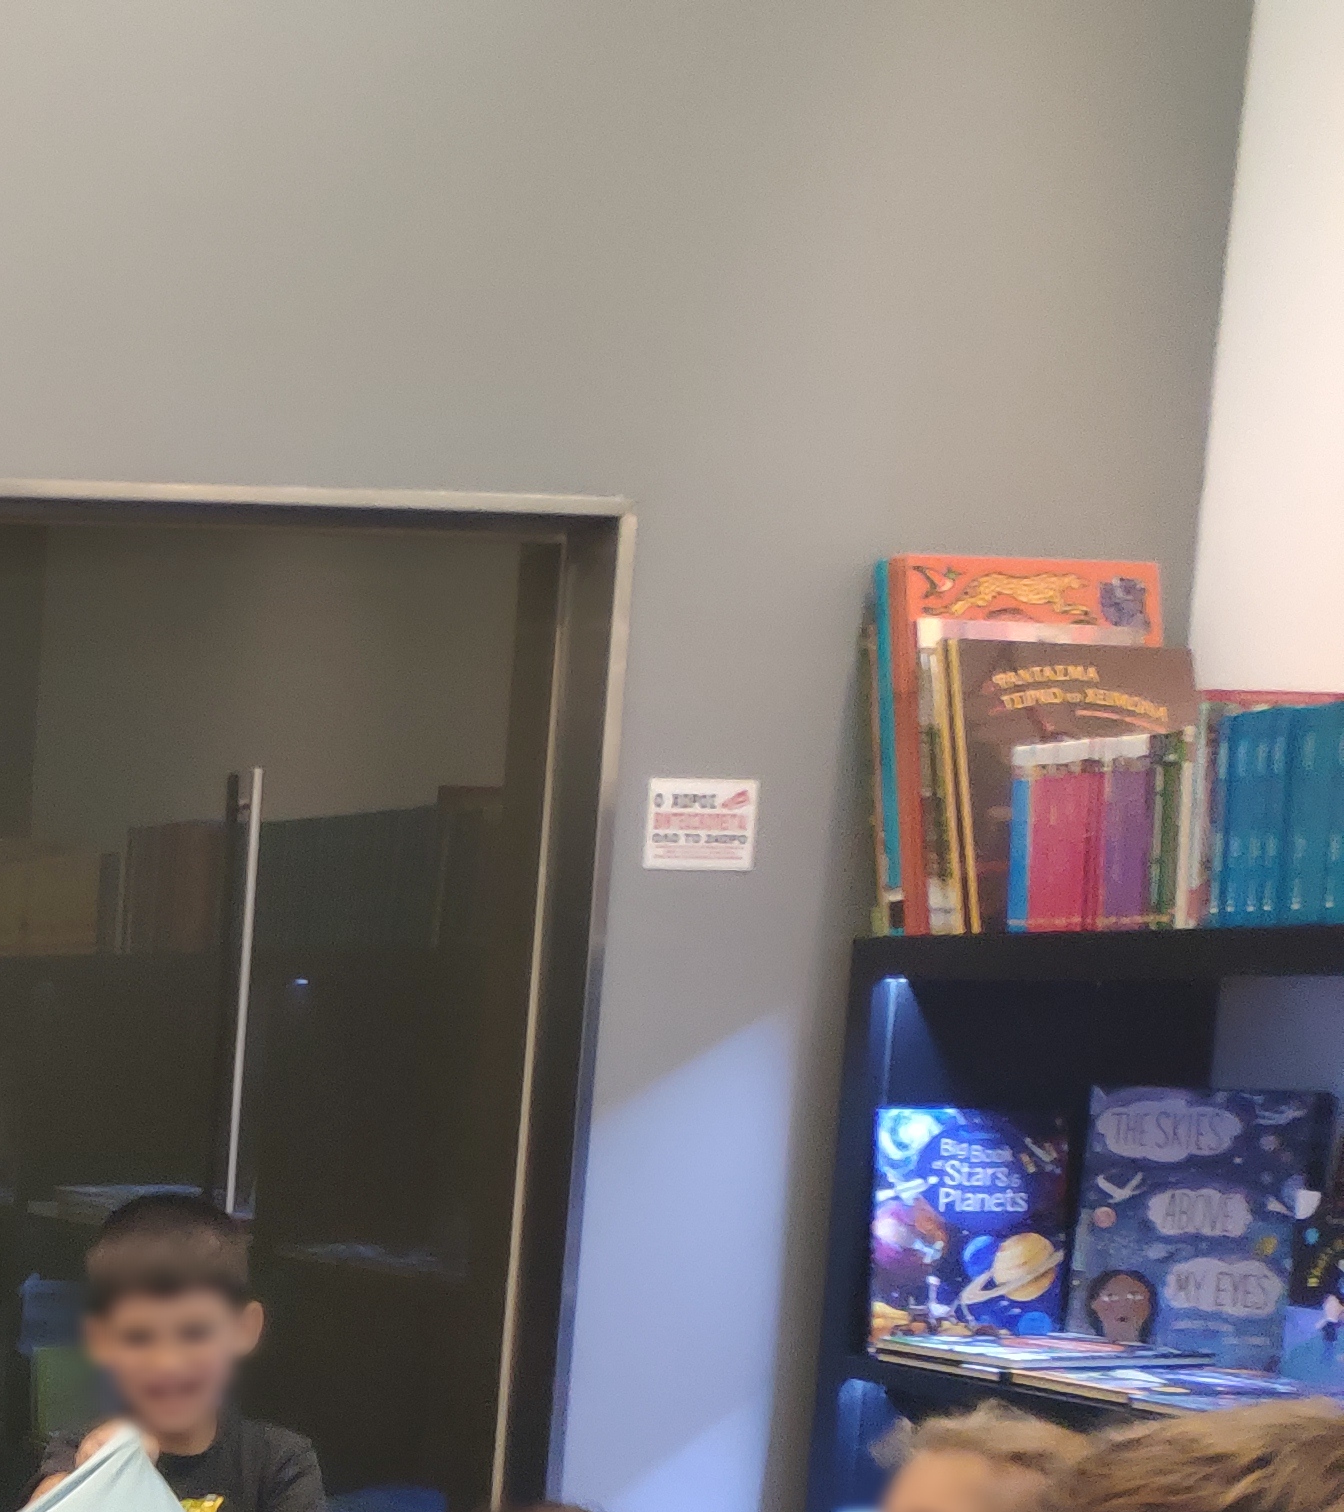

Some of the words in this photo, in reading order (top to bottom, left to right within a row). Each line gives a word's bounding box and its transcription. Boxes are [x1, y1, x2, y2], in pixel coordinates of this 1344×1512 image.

[1111, 1111, 1148, 1148] THE
[1154, 1110, 1222, 1151] SKIES
[940, 1138, 969, 1159] Big
[970, 1145, 1014, 1163] Book
[943, 1159, 1010, 1187] Stars
[938, 1187, 1029, 1213] Planets
[1164, 1192, 1235, 1235] ABOVE
[1214, 1270, 1270, 1310] EYES
